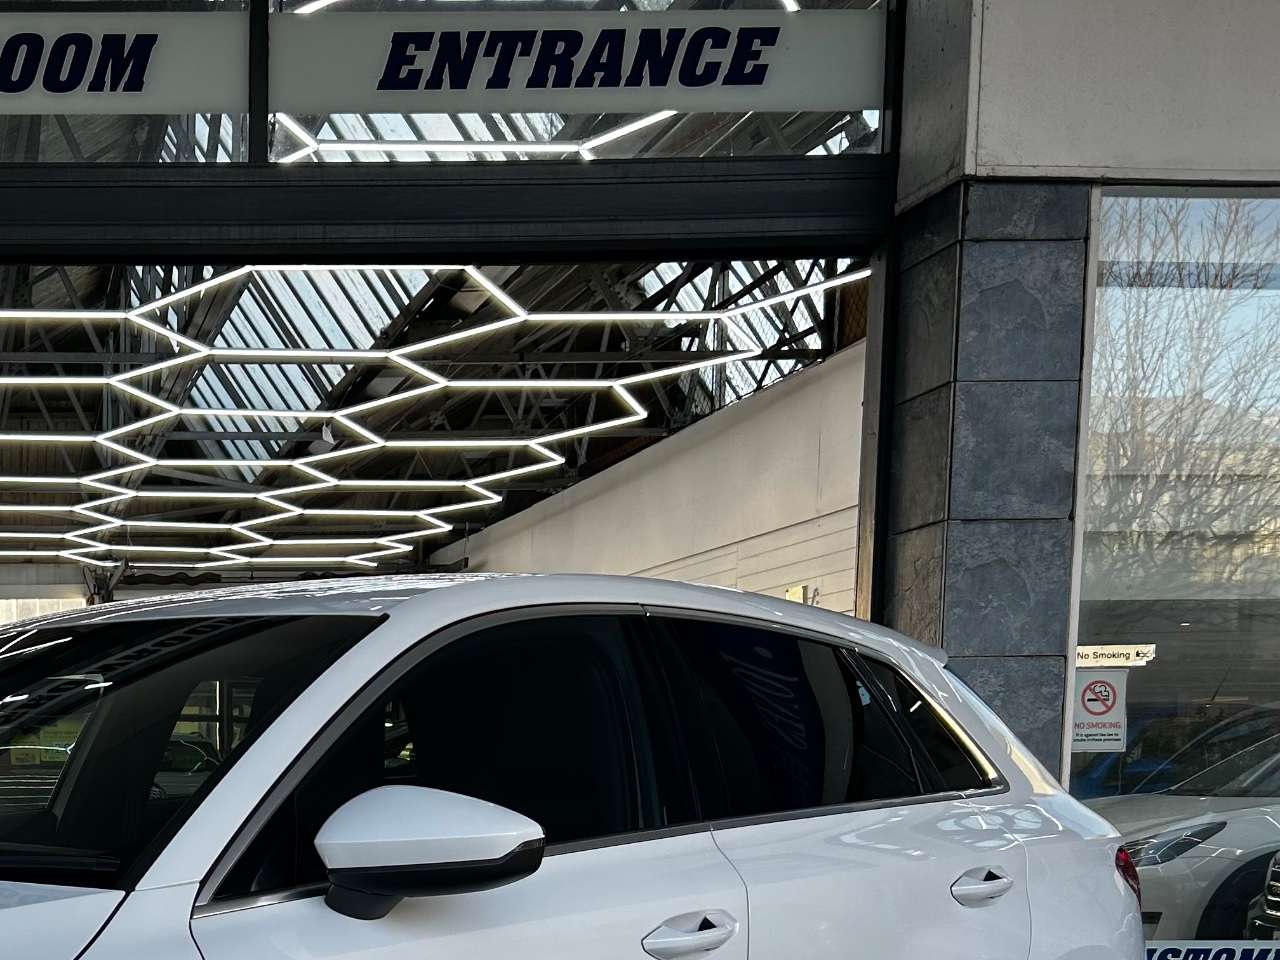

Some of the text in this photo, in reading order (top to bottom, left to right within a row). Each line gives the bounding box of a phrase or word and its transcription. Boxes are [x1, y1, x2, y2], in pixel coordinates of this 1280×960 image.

[376, 26, 781, 91] ENTRANCE
[1077, 651, 1131, 660] No Smoking
[1074, 722, 1121, 730] NO SMOKING
